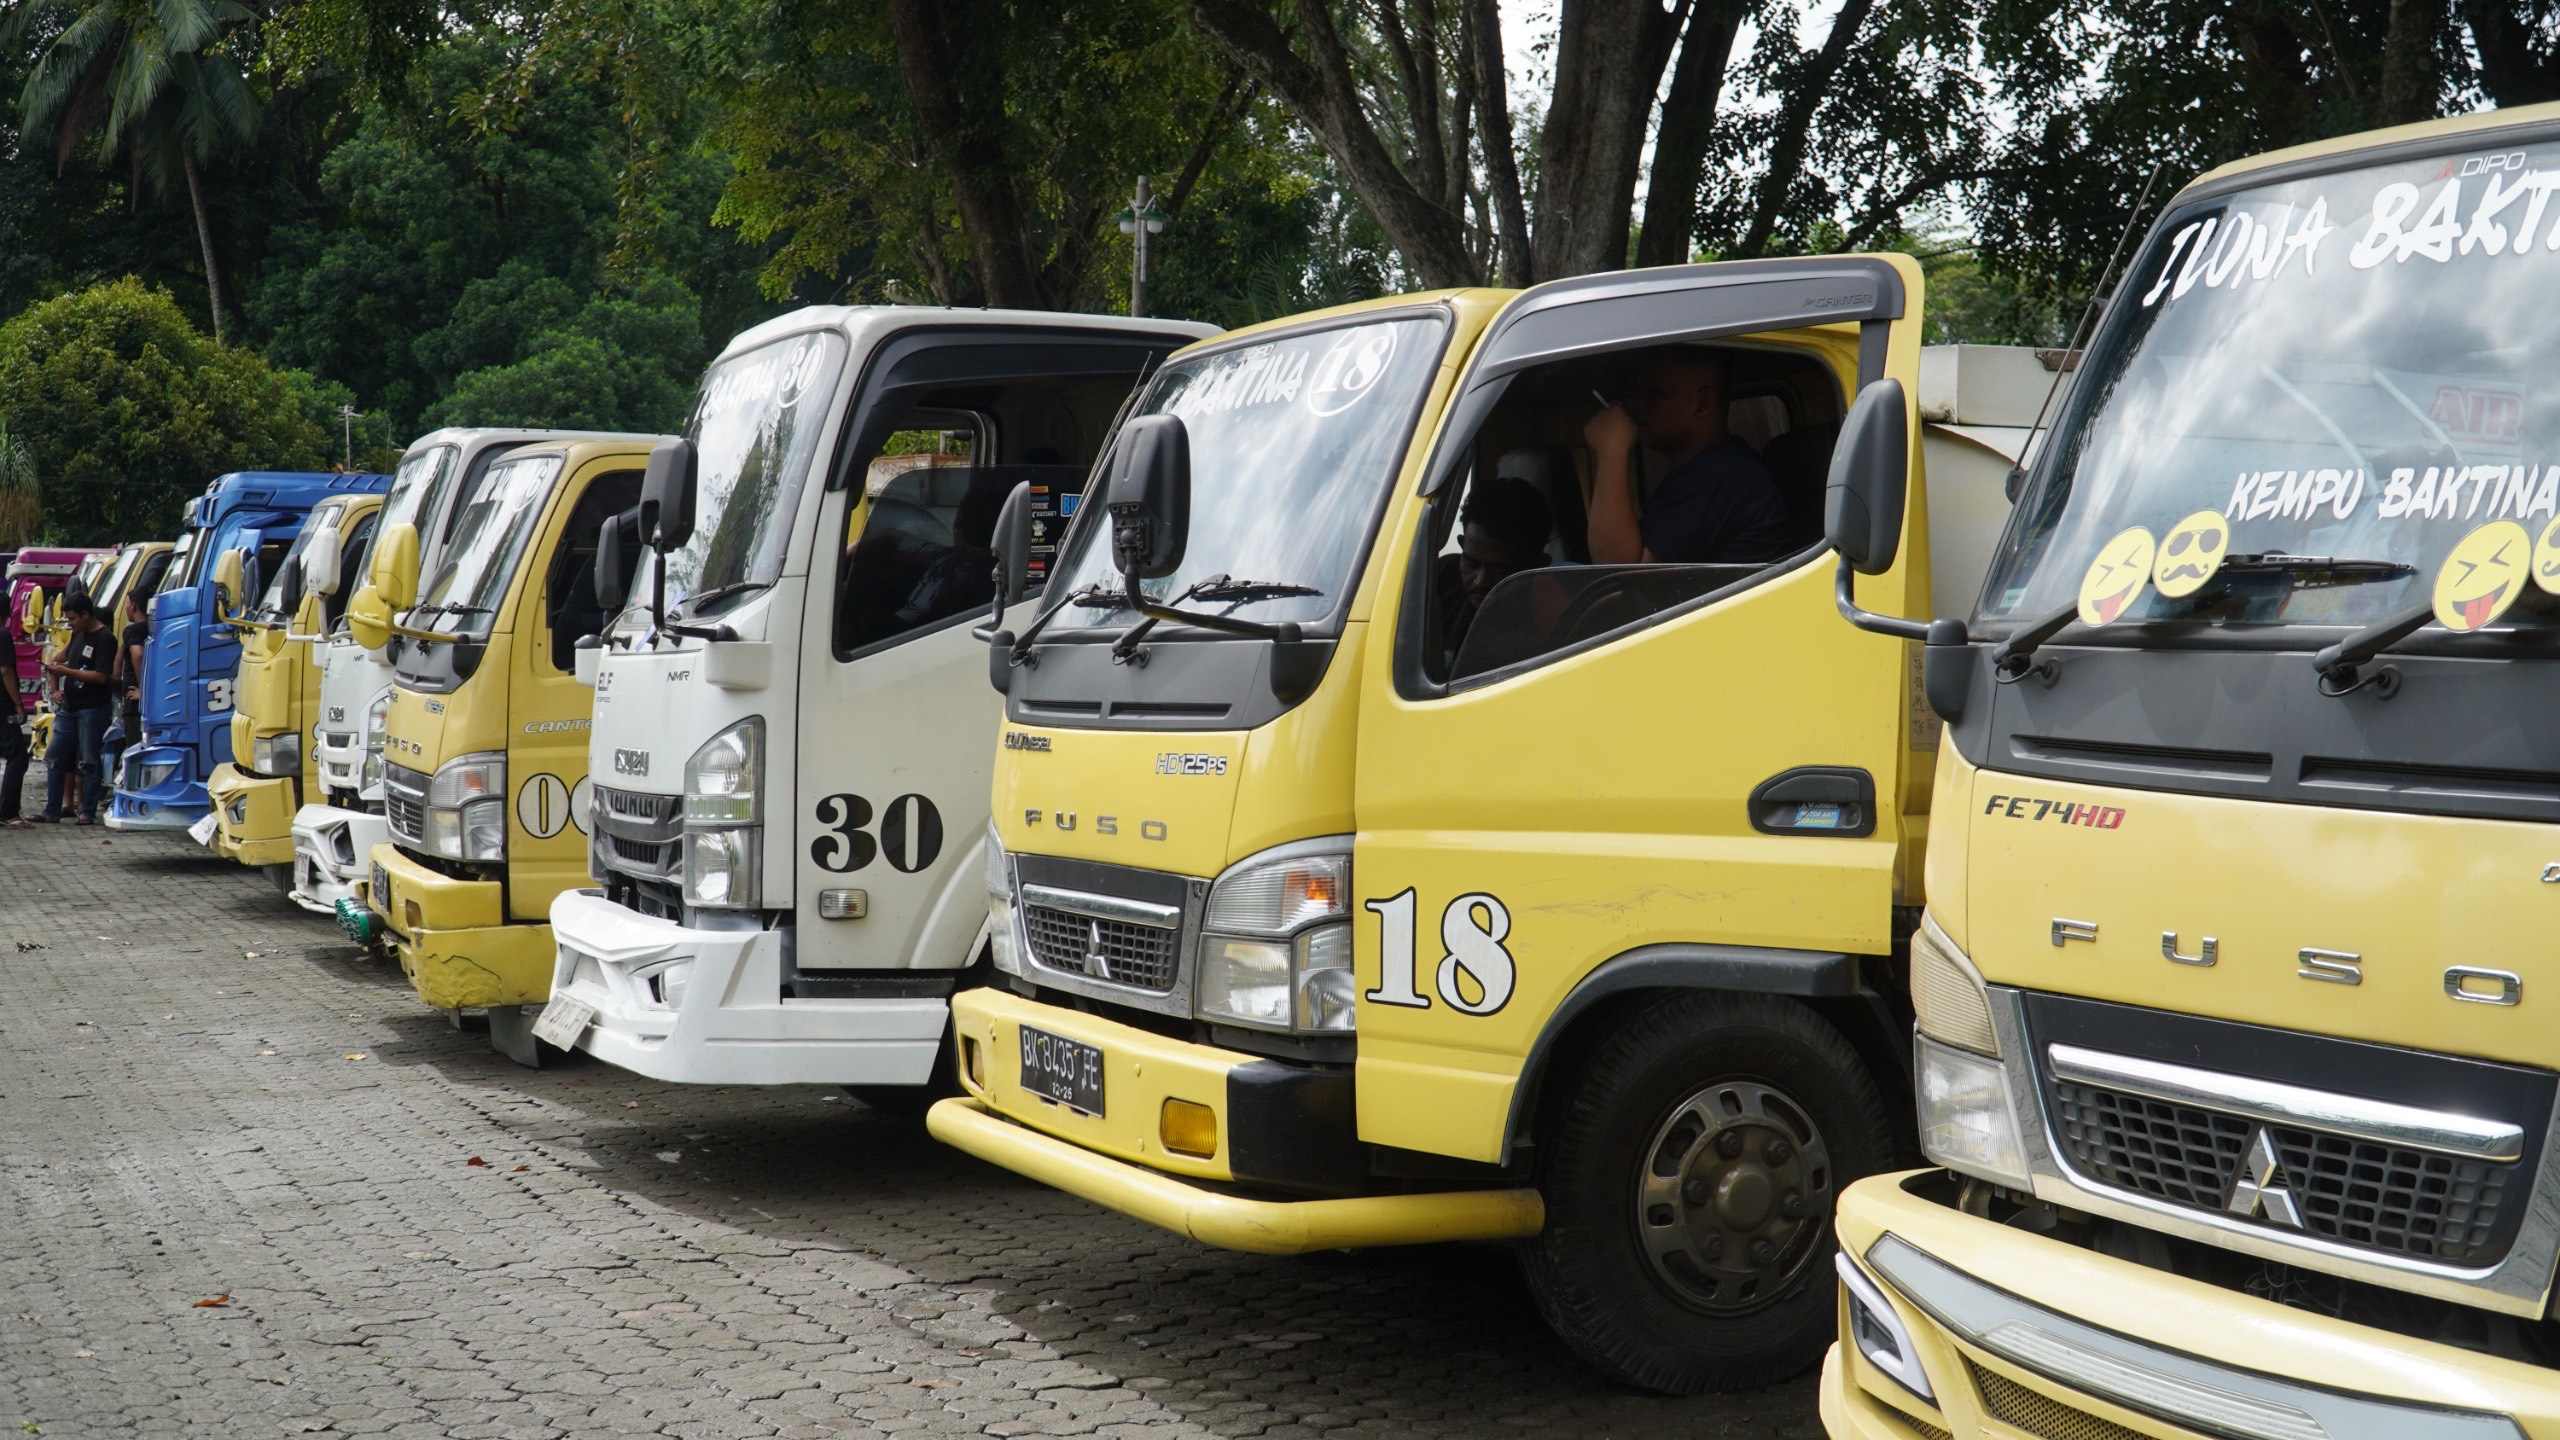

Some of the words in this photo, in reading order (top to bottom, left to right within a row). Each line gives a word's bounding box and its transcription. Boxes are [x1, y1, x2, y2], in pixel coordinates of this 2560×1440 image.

[2460, 152, 2526, 176] DIPO
[2142, 195, 2334, 307] ILONA
[1815, 293, 1873, 308] CANTER
[781, 343, 822, 392] 30
[1311, 335, 1391, 394] 18
[2429, 388, 2523, 442] AIR
[2225, 467, 2365, 522] KEMPU
[2379, 463, 2560, 519] BAKTINA
[667, 671, 690, 682] NMR
[1155, 753, 1228, 775] HD125PS
[811, 793, 944, 874] 30
[1025, 809, 1168, 842] FUSO
[1984, 794, 2126, 830] FE74HD
[1364, 885, 1517, 1017] 18
[2051, 917, 2523, 1006] FUSO
[1023, 1030, 1039, 1070] BK
[1043, 1036, 1075, 1081] 8435
